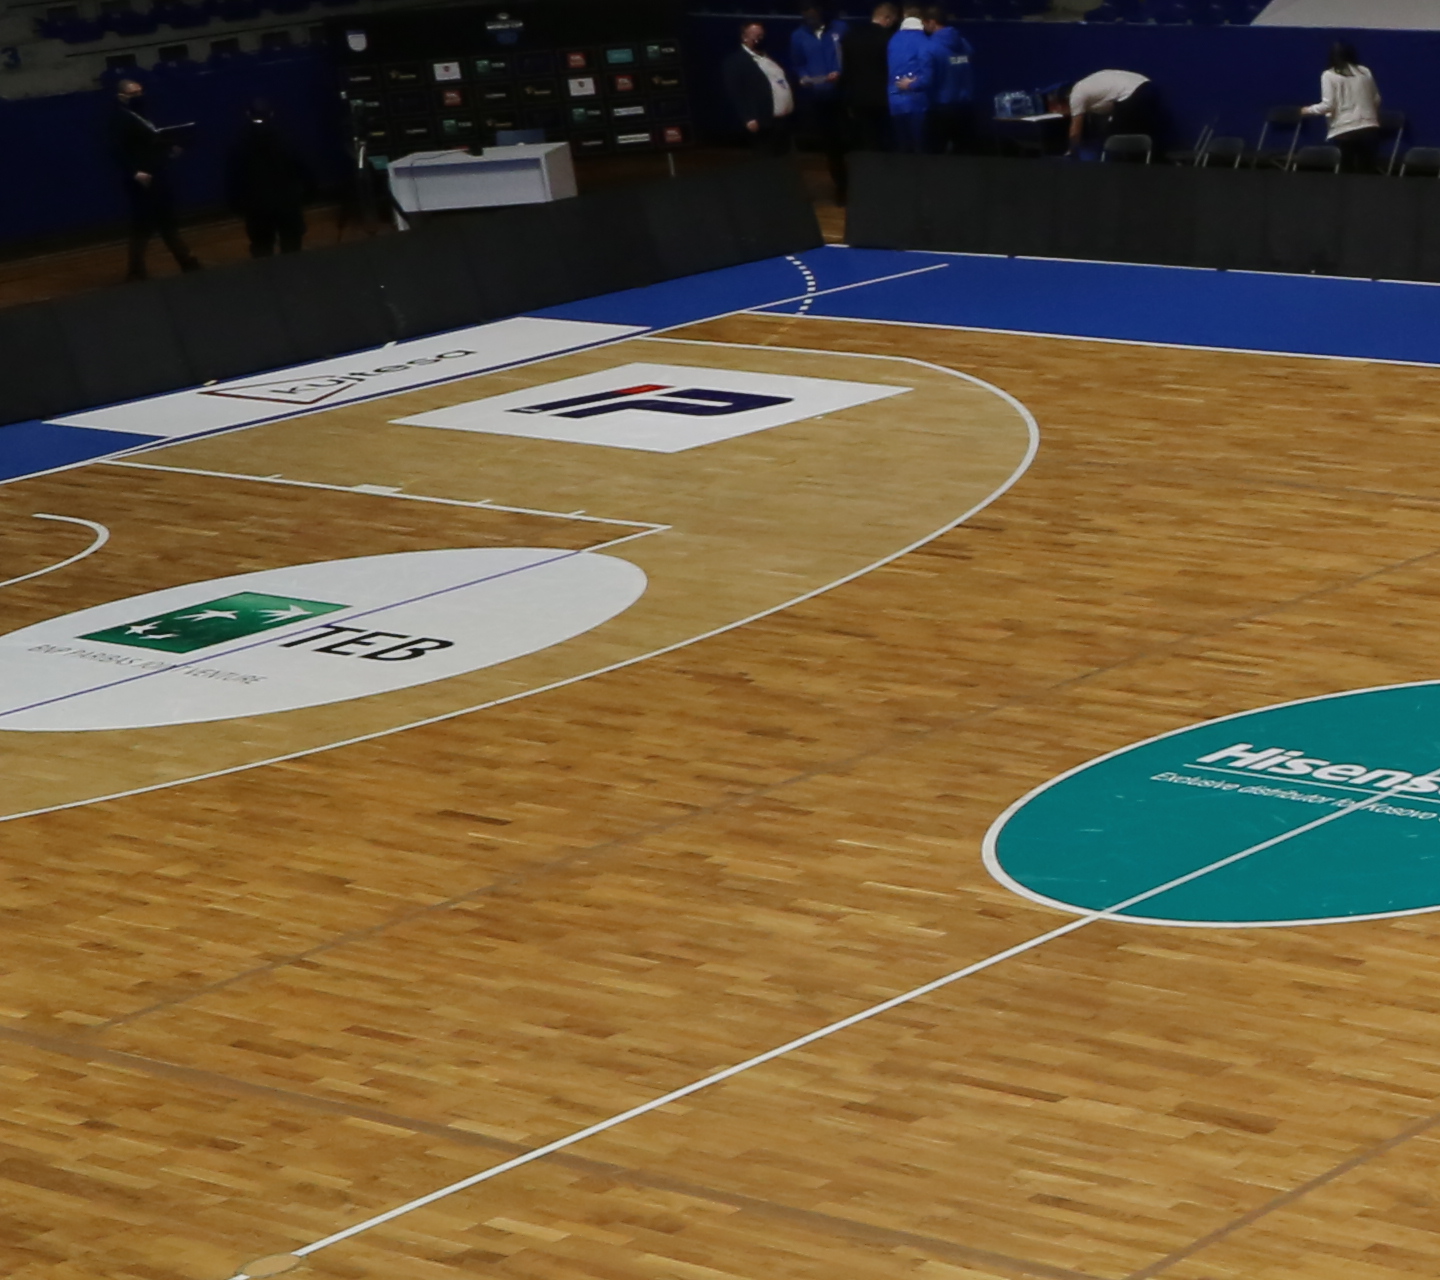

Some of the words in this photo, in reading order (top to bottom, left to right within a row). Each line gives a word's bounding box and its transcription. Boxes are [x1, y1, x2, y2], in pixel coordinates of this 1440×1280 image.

[269, 345, 478, 398] kujtesa
[279, 625, 455, 662] TEB
[1150, 771, 1241, 792] Exclusive
